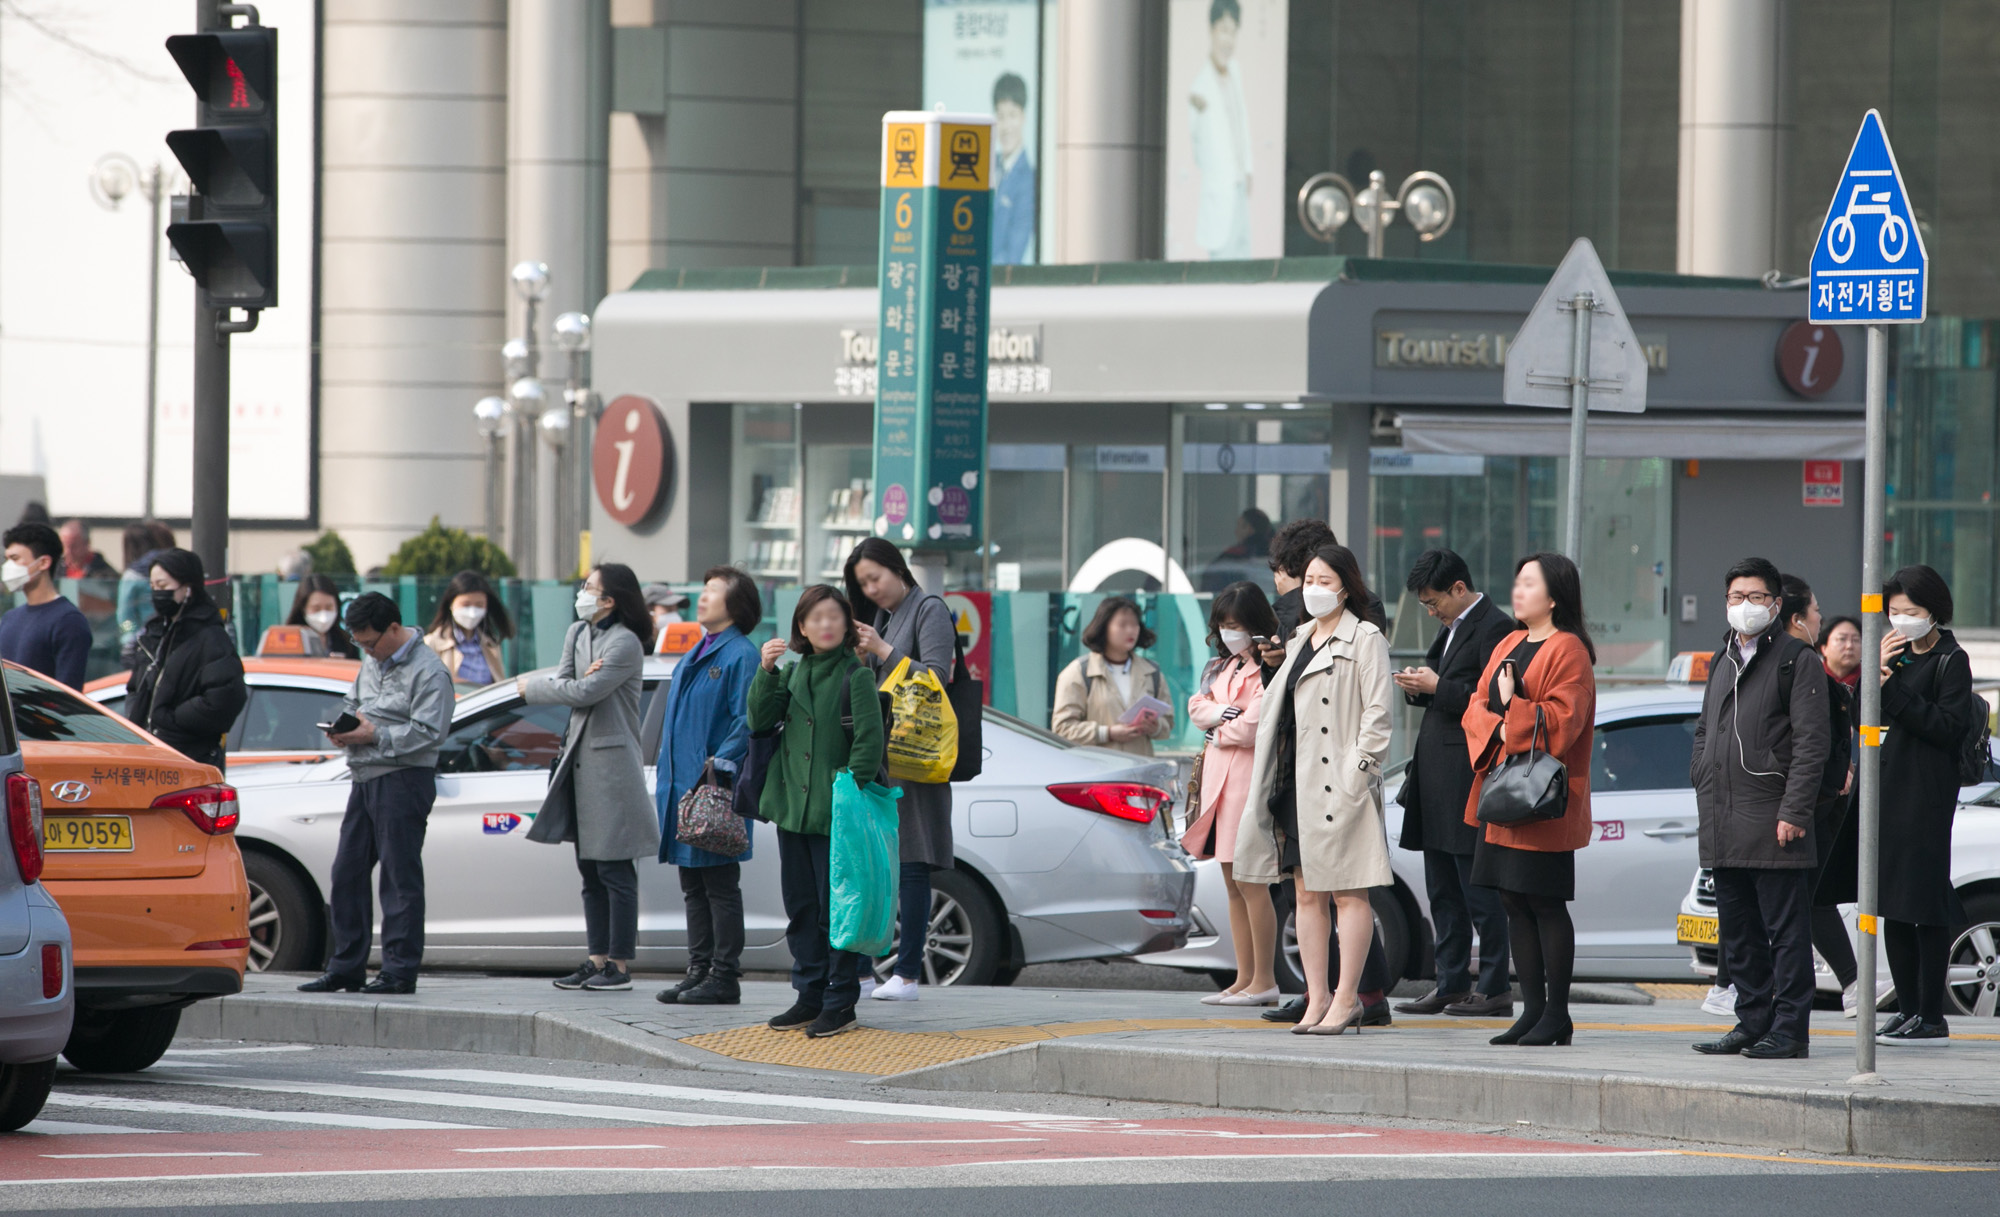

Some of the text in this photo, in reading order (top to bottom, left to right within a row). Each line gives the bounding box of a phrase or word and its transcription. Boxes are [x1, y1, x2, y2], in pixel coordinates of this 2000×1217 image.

[895, 192, 912, 229] 6
[953, 195, 973, 231] 6
[1818, 279, 1915, 313] 자전거횡단
[886, 261, 904, 377] 광화문
[940, 263, 963, 379] 광화문
[1380, 332, 1490, 365] Tourist
[91, 767, 180, 786] 뉴서울택시059
[45, 821, 121, 845] 아 9059
[484, 814, 510, 831] 개인
